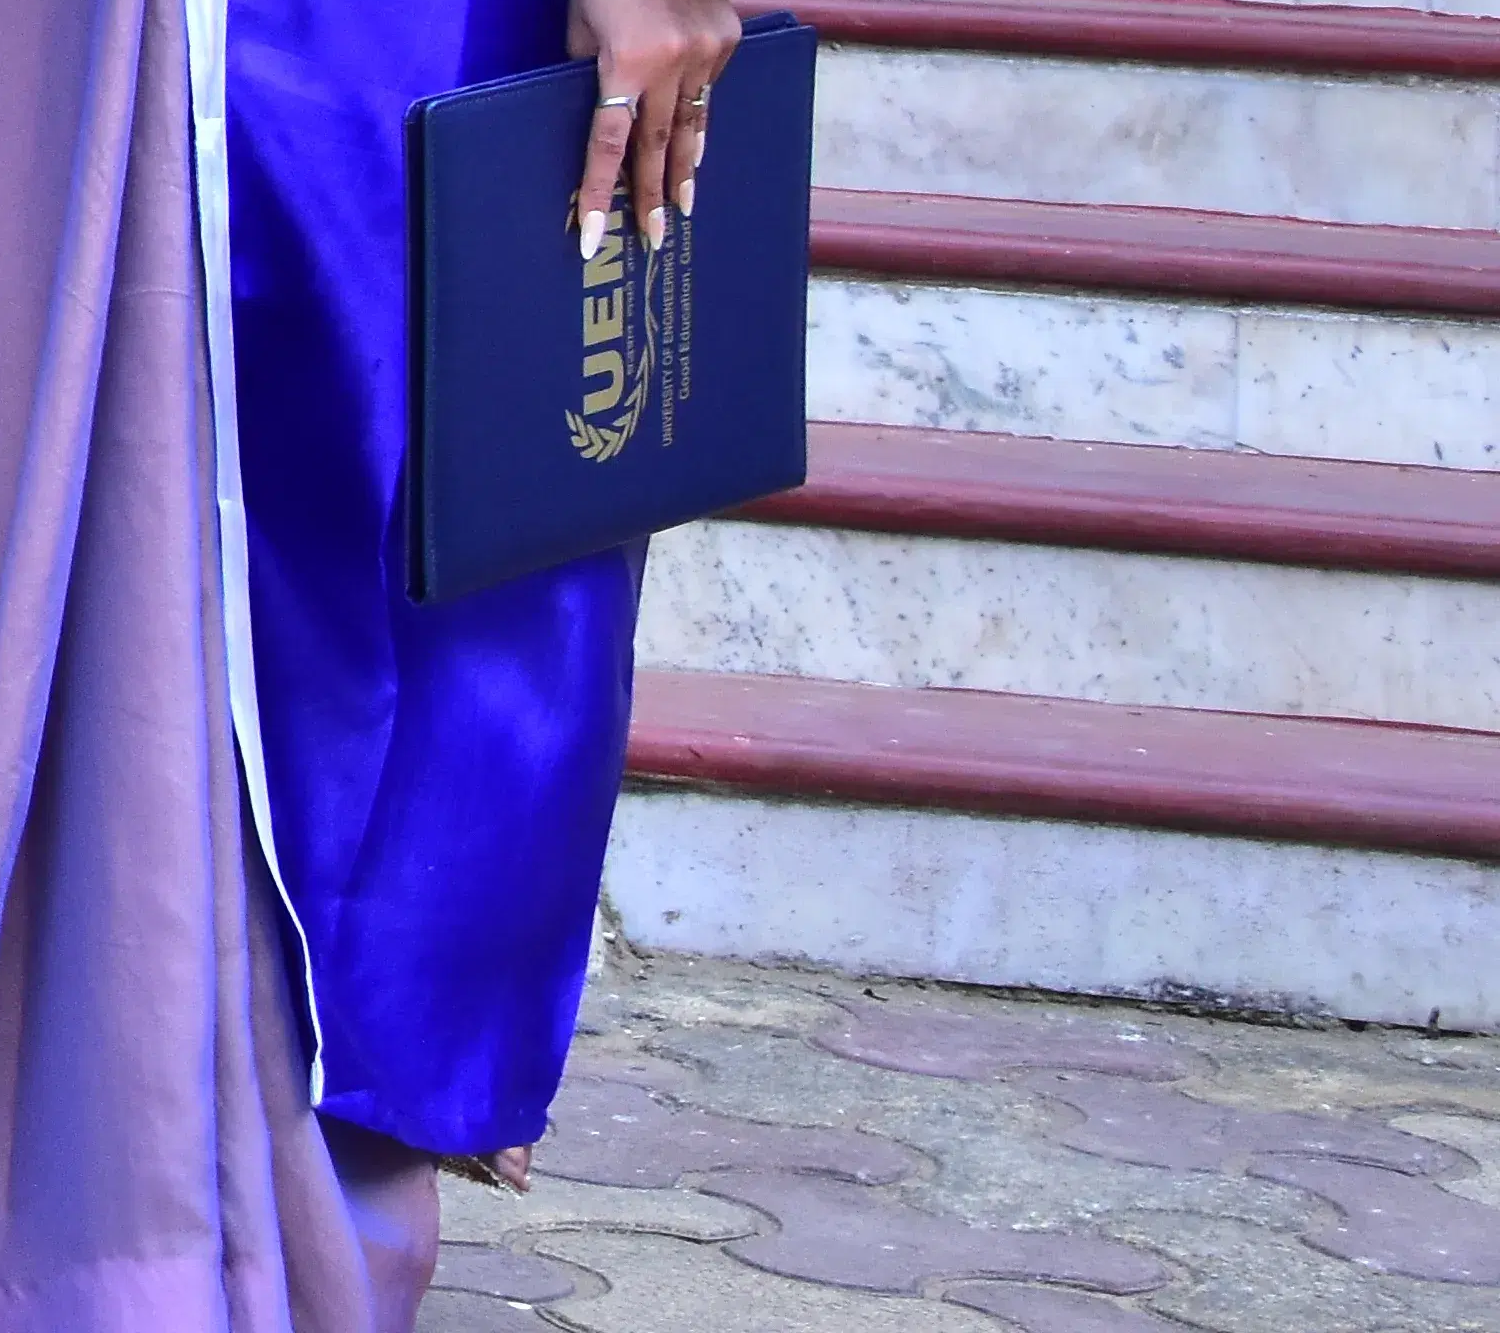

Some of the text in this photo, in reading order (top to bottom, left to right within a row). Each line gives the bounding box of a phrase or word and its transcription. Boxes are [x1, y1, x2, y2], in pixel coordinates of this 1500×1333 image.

[583, 209, 624, 415] UEM
[662, 253, 674, 344] ENGINEERING
[662, 347, 674, 365] OF
[679, 356, 690, 400] Good
[662, 368, 674, 447] UNIVERSITY
